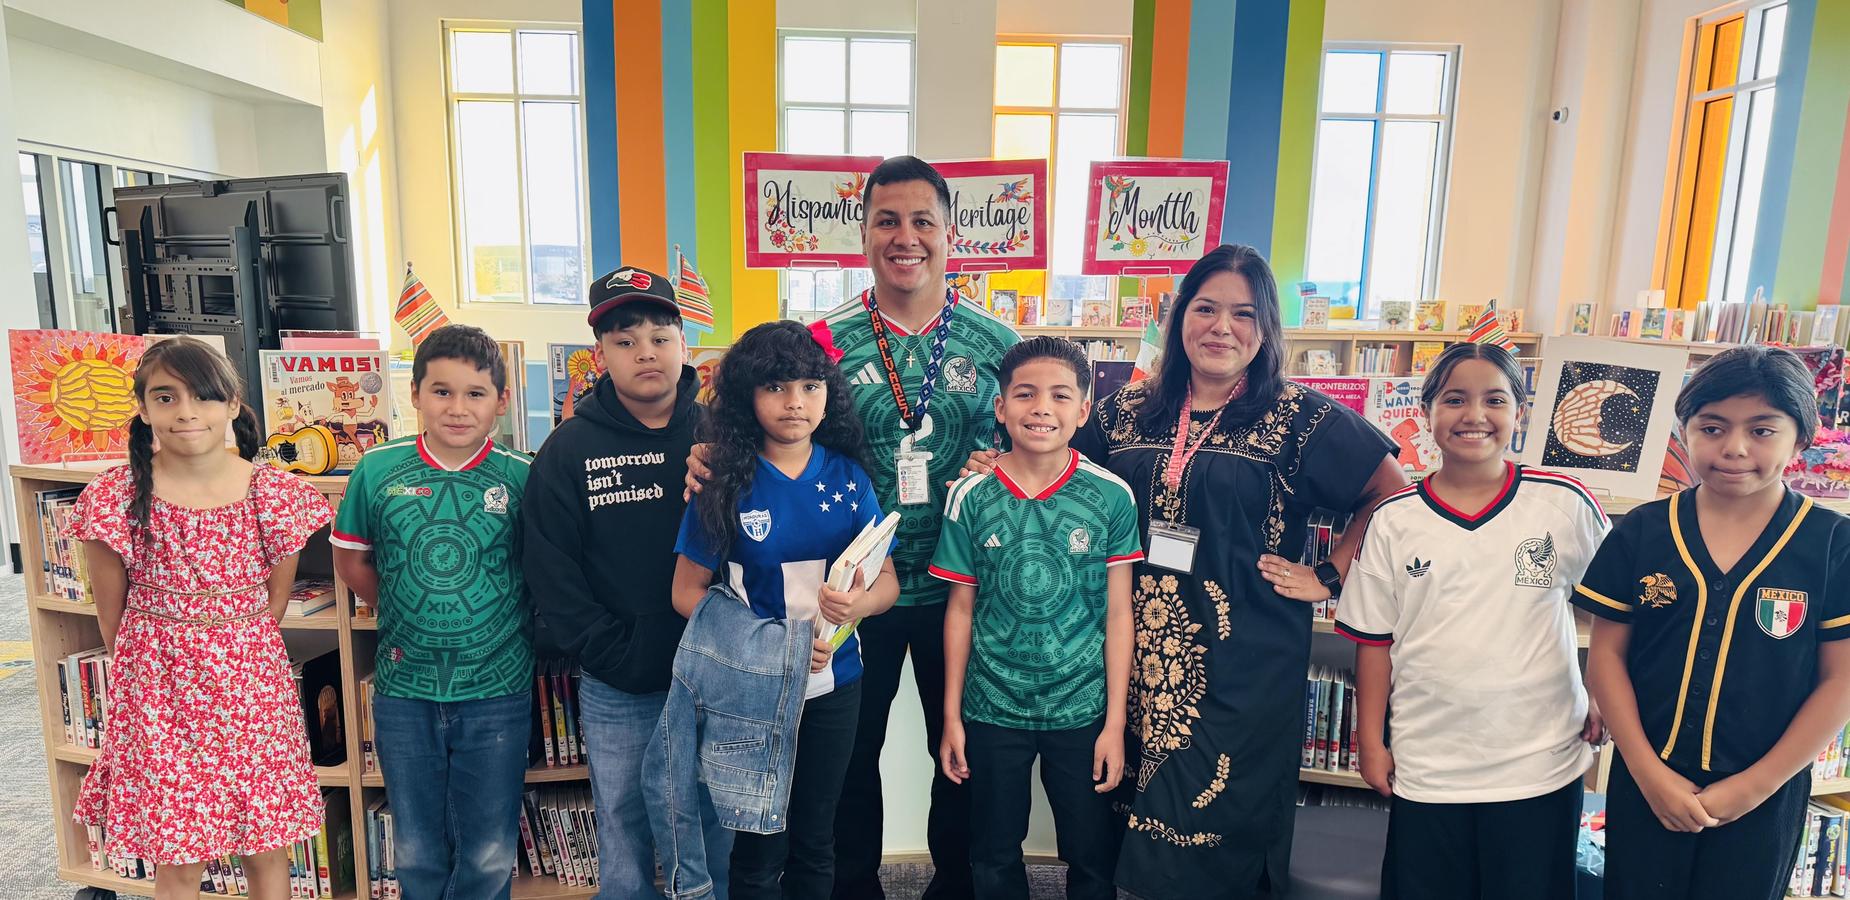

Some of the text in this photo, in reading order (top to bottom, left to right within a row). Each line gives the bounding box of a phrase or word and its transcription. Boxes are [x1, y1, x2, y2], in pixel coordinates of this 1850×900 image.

[763, 180, 864, 234] Hispanic
[1108, 186, 1200, 240] Montth
[280, 356, 380, 372] VAMOS!
[289, 375, 313, 385] Vamos
[1311, 382, 1366, 391] FRONTERIZOS
[289, 381, 325, 395] mercado
[1385, 396, 1423, 408] WANT
[585, 452, 665, 471] tomorrow
[586, 469, 623, 491] isn't
[588, 482, 664, 511] promised
[1761, 589, 1805, 602] MEXICO
